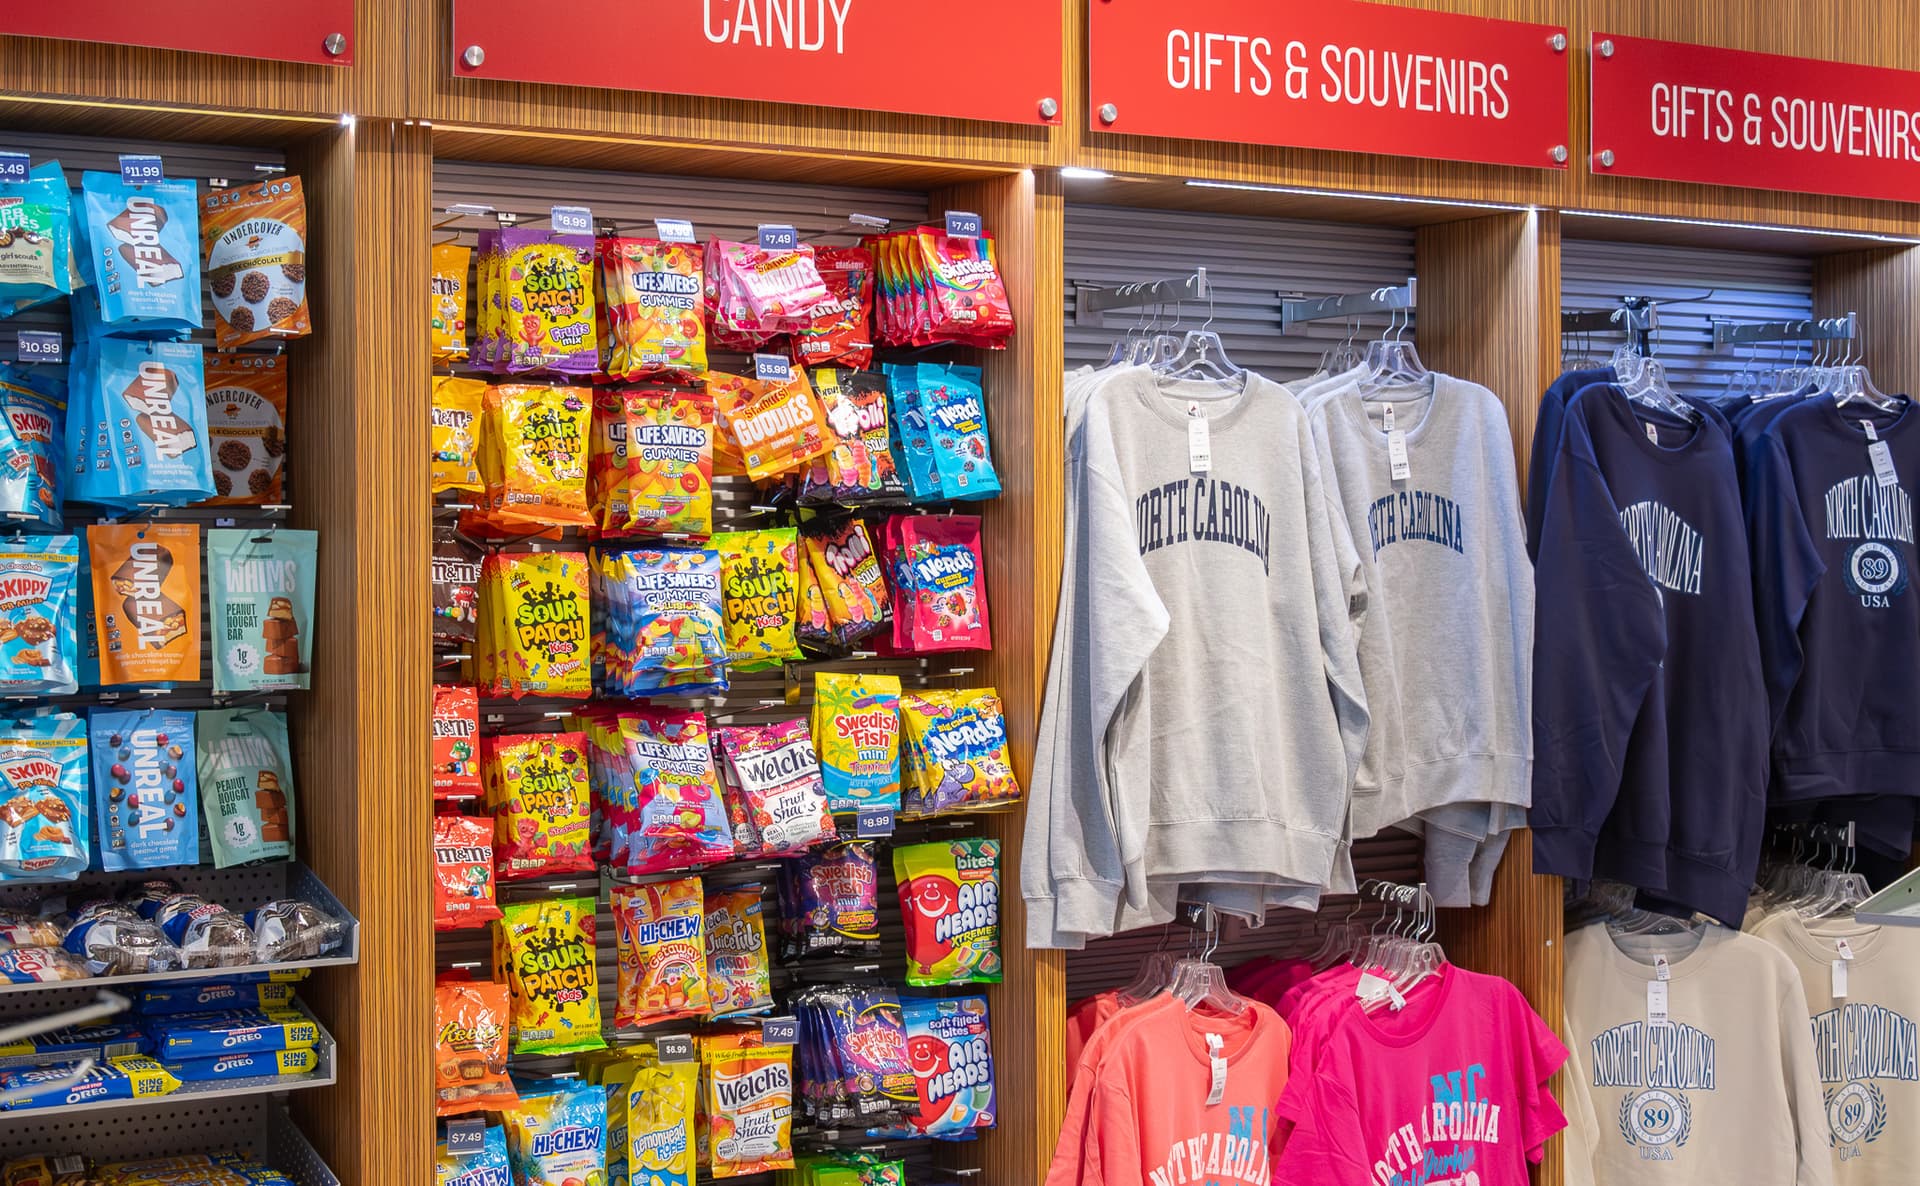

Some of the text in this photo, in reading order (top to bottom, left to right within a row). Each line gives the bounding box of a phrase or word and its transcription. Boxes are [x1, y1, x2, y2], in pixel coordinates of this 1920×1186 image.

[702, 0, 851, 54] CANDY
[1166, 28, 1509, 120] GIFTS & SOUVENIRS
[1651, 82, 1734, 143] GIFTS
[1742, 92, 1763, 146] &
[125, 165, 160, 177] $11.99
[222, 220, 284, 246] UNDERCOVER
[952, 221, 976, 232] $7.49
[126, 196, 168, 289] UNREAL
[765, 234, 791, 244] $7.49
[243, 256, 283, 269] CHOCOLATE
[525, 271, 580, 290] SOUR
[525, 285, 585, 312] PATCH
[640, 295, 695, 310] GUMMIES
[551, 321, 591, 342] Fruits
[562, 336, 583, 346] mix
[20, 341, 60, 354] $10.99
[759, 363, 787, 375] $5.99
[138, 360, 182, 462] UNREAL
[12, 411, 52, 433] SKIPPY
[732, 393, 815, 449] GOODIES
[642, 449, 699, 463] GUMMIES
[1825, 476, 1861, 539] NORTH
[1136, 478, 1189, 557] ORTH
[223, 558, 297, 594] WHIMS
[1860, 557, 1890, 580] 89
[728, 571, 788, 598] SOUR
[129, 542, 167, 650] UNREAL
[645, 590, 710, 603] GUMMIES
[1860, 594, 1891, 608] USA
[226, 602, 257, 616] PEANUT
[518, 600, 579, 625] SOUR
[727, 590, 795, 624] PATCH
[226, 614, 259, 629] NOUGAT
[756, 615, 783, 629] Kids
[226, 628, 244, 641] BAR
[517, 617, 585, 651] PATCH
[549, 641, 574, 654] Kids
[835, 713, 900, 737] Swedish
[851, 727, 890, 749] Fish
[857, 749, 888, 760] mini
[6, 762, 59, 781] SKIPPY
[649, 760, 706, 775] GUMMIES
[745, 748, 818, 783] Welch's
[129, 729, 169, 840] UNREAL
[214, 775, 247, 794] PEANUT
[521, 774, 571, 794] SOUR
[217, 787, 251, 803] NOUGAT
[779, 791, 805, 811] Fruit
[220, 802, 238, 817] BAR
[436, 847, 492, 864] m&m's
[957, 854, 995, 870] bites
[811, 862, 873, 884] Swedish
[829, 879, 865, 897] Fish
[959, 881, 998, 912] AIR
[935, 903, 998, 944] HEADS
[707, 920, 762, 956] Juicefuls
[520, 943, 586, 974] SOUR
[649, 943, 701, 967] Getaway
[521, 962, 594, 1000] PATCH
[196, 989, 236, 1004] OREO
[556, 988, 583, 1003] Kids
[289, 1025, 314, 1034] KING
[929, 1013, 980, 1030] soft filled
[222, 1031, 262, 1048] OREO
[289, 1033, 315, 1042] SIZE
[768, 1027, 794, 1037] $7.49
[942, 1026, 968, 1039] bites
[1843, 1003, 1919, 1082] CAROLINA
[282, 1050, 307, 1059] KING
[282, 1058, 306, 1068] SIZE
[949, 1038, 988, 1070] AIR
[1590, 1020, 1716, 1091] NORTH CAROLINA
[213, 1057, 254, 1073] OREO
[137, 1078, 164, 1088] KING
[138, 1086, 163, 1095] SIZE
[716, 1065, 788, 1106] Welch's
[928, 1060, 990, 1103] HEADS
[66, 1086, 108, 1105] OREO
[740, 1111, 769, 1129] Fruit
[1643, 1107, 1670, 1129] 89
[1844, 1102, 1862, 1127] 89
[452, 1132, 482, 1144] $7.49
[633, 1117, 687, 1158] Lemonhead
[733, 1121, 775, 1142] Snacks
[1639, 1145, 1674, 1161] USA
